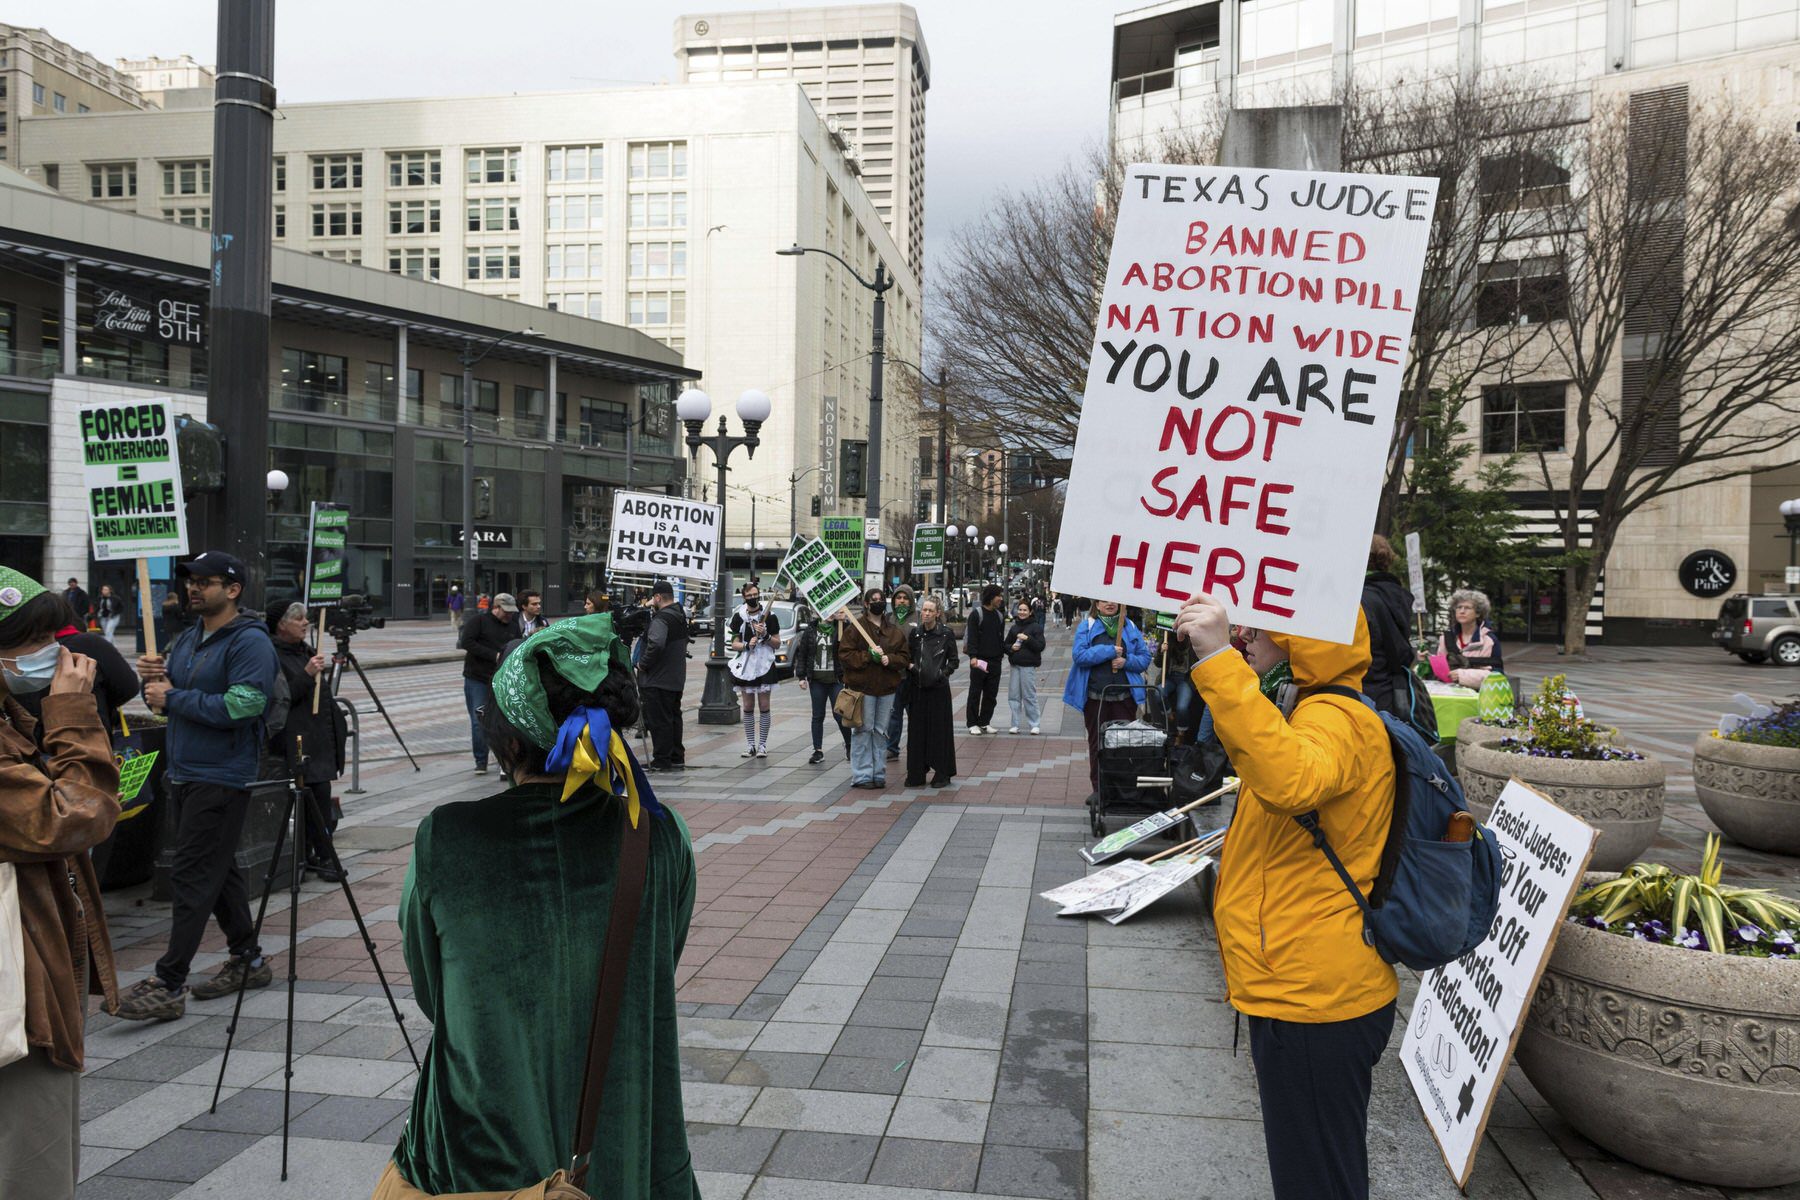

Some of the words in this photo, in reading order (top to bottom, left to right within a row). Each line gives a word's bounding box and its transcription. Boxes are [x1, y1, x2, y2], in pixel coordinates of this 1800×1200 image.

[1134, 174, 1269, 211] TEXAS
[1290, 179, 1431, 221] JUDGE
[1185, 221, 1366, 264] BANNED
[1121, 262, 1323, 303] ABORTION
[1335, 277, 1412, 312] PILL
[95, 310, 147, 332] Avenue
[159, 299, 200, 322] OFF
[159, 319, 200, 343] 5TH
[1107, 303, 1275, 343] NATION
[1293, 324, 1402, 365] WIDE
[1100, 339, 1220, 400] YOU
[1246, 357, 1377, 425] ARE
[80, 404, 166, 442] FORCED
[1158, 405, 1302, 462] NOT
[85, 438, 169, 462] MOTHERHOOD
[824, 401, 834, 506] NORDSTROM
[91, 482, 175, 517] FEMALE
[621, 499, 714, 526] ABORTION
[1140, 466, 1295, 536] SAFE
[95, 516, 178, 538] ENSLAVEMENT
[618, 530, 711, 554] HUMAN
[654, 521, 667, 531] IS
[670, 524, 680, 533] A
[824, 520, 849, 530] LEGAL
[824, 531, 860, 540] ABORTION
[616, 547, 710, 570] RIGHT
[785, 540, 826, 577] FORCED
[832, 550, 860, 558] WITHOUT
[835, 541, 860, 549] DEMAND
[794, 552, 832, 583] MOTHERHOOD
[840, 558, 859, 568] LOGY
[1103, 534, 1299, 618] HERE
[807, 567, 847, 603] FEMALE
[815, 580, 854, 610] ENSLAVEMENT
[1490, 800, 1529, 846] Fascist
[1525, 824, 1571, 877] Judges:
[1510, 861, 1548, 918] Your
[1499, 917, 1530, 966] Off
[1457, 949, 1503, 1013] ortion
[1428, 965, 1498, 1074] Medication!
